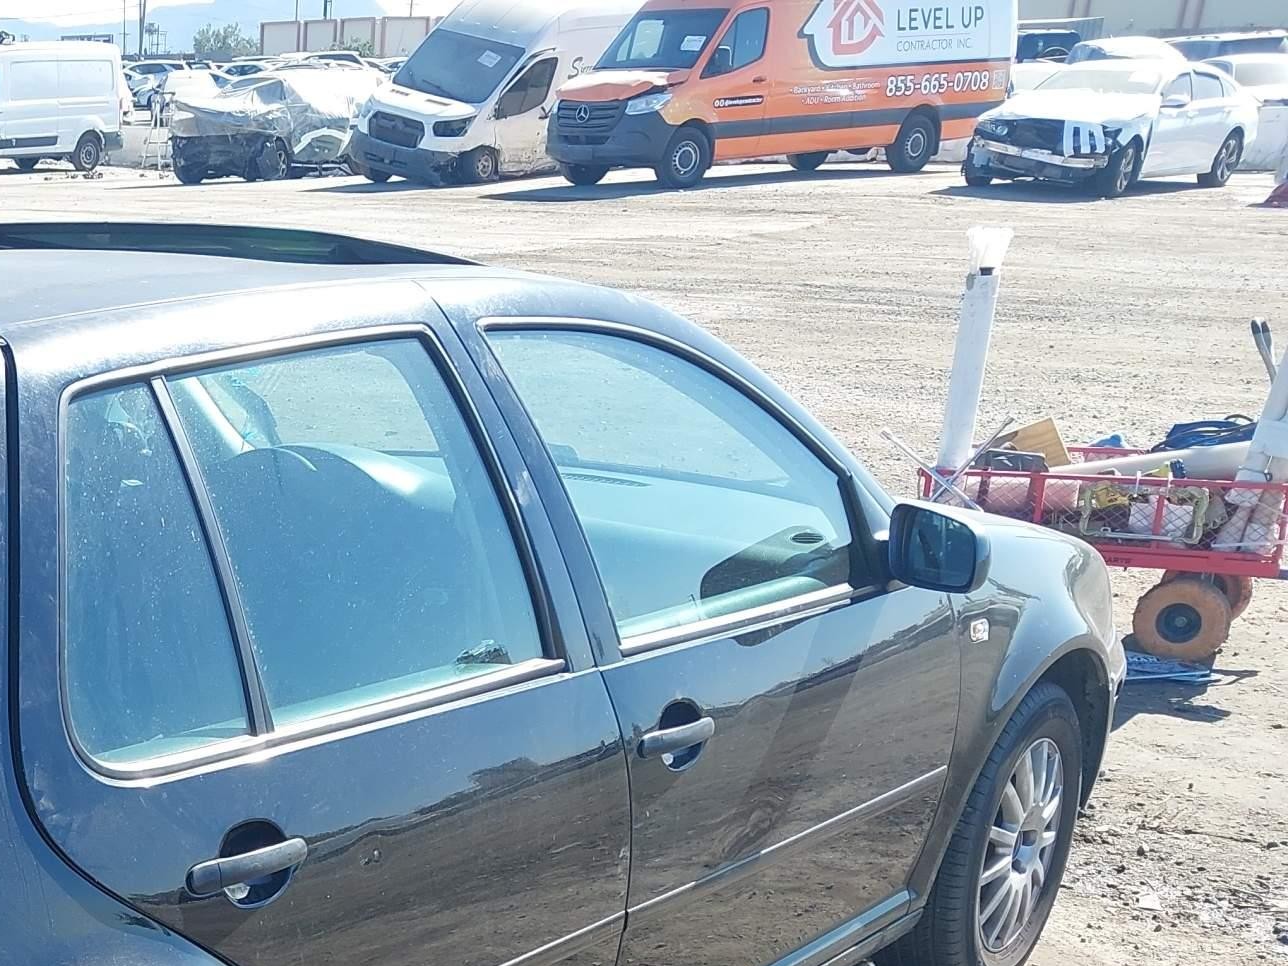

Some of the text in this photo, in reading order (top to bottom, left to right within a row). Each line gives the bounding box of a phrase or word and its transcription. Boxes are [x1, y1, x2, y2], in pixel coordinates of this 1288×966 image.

[897, 6, 984, 31] LEVEL UP
[896, 38, 953, 52] CONTRACTOR
[885, 70, 990, 97] 855-665-0708
